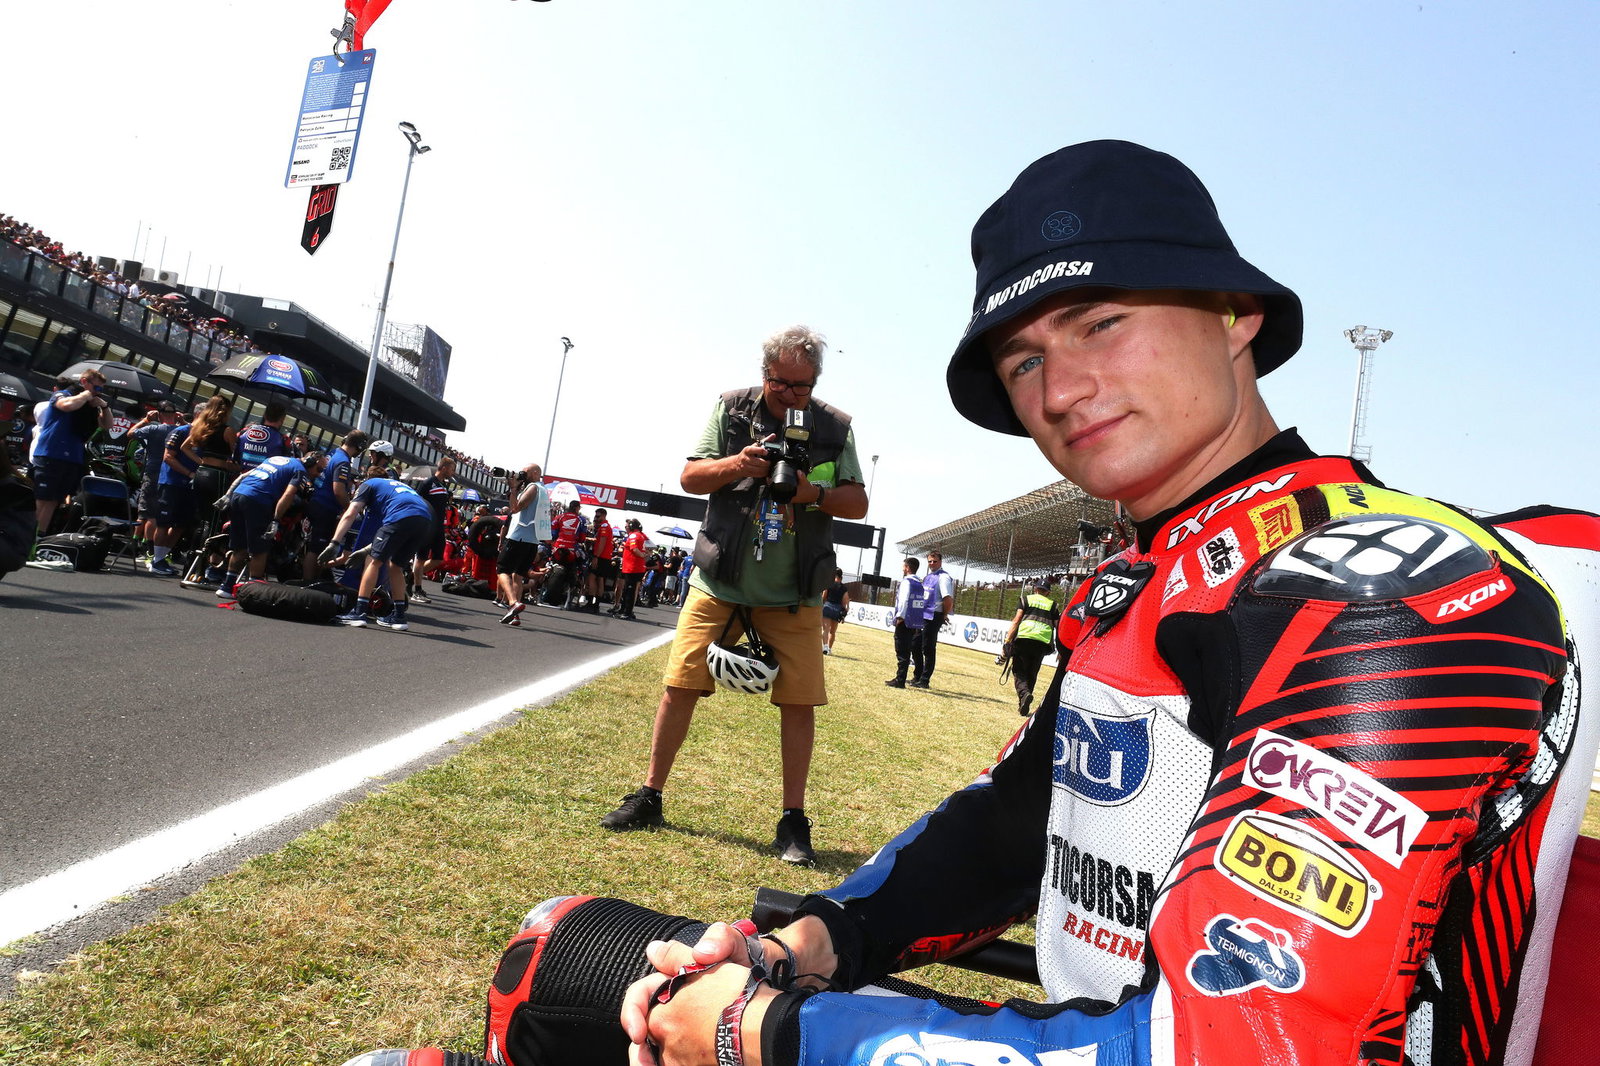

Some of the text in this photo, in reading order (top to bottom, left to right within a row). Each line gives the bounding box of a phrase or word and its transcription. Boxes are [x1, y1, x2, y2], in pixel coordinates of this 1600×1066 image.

[307, 186, 337, 222] GRID
[984, 261, 1094, 315] MOTOCORSA
[243, 442, 268, 453] YAMAHA
[1051, 834, 1157, 931] TOCORSA
[1234, 834, 1354, 913] BONI
[1259, 877, 1303, 903] DAL 1912
[1217, 935, 1286, 983] TERMIGNON
